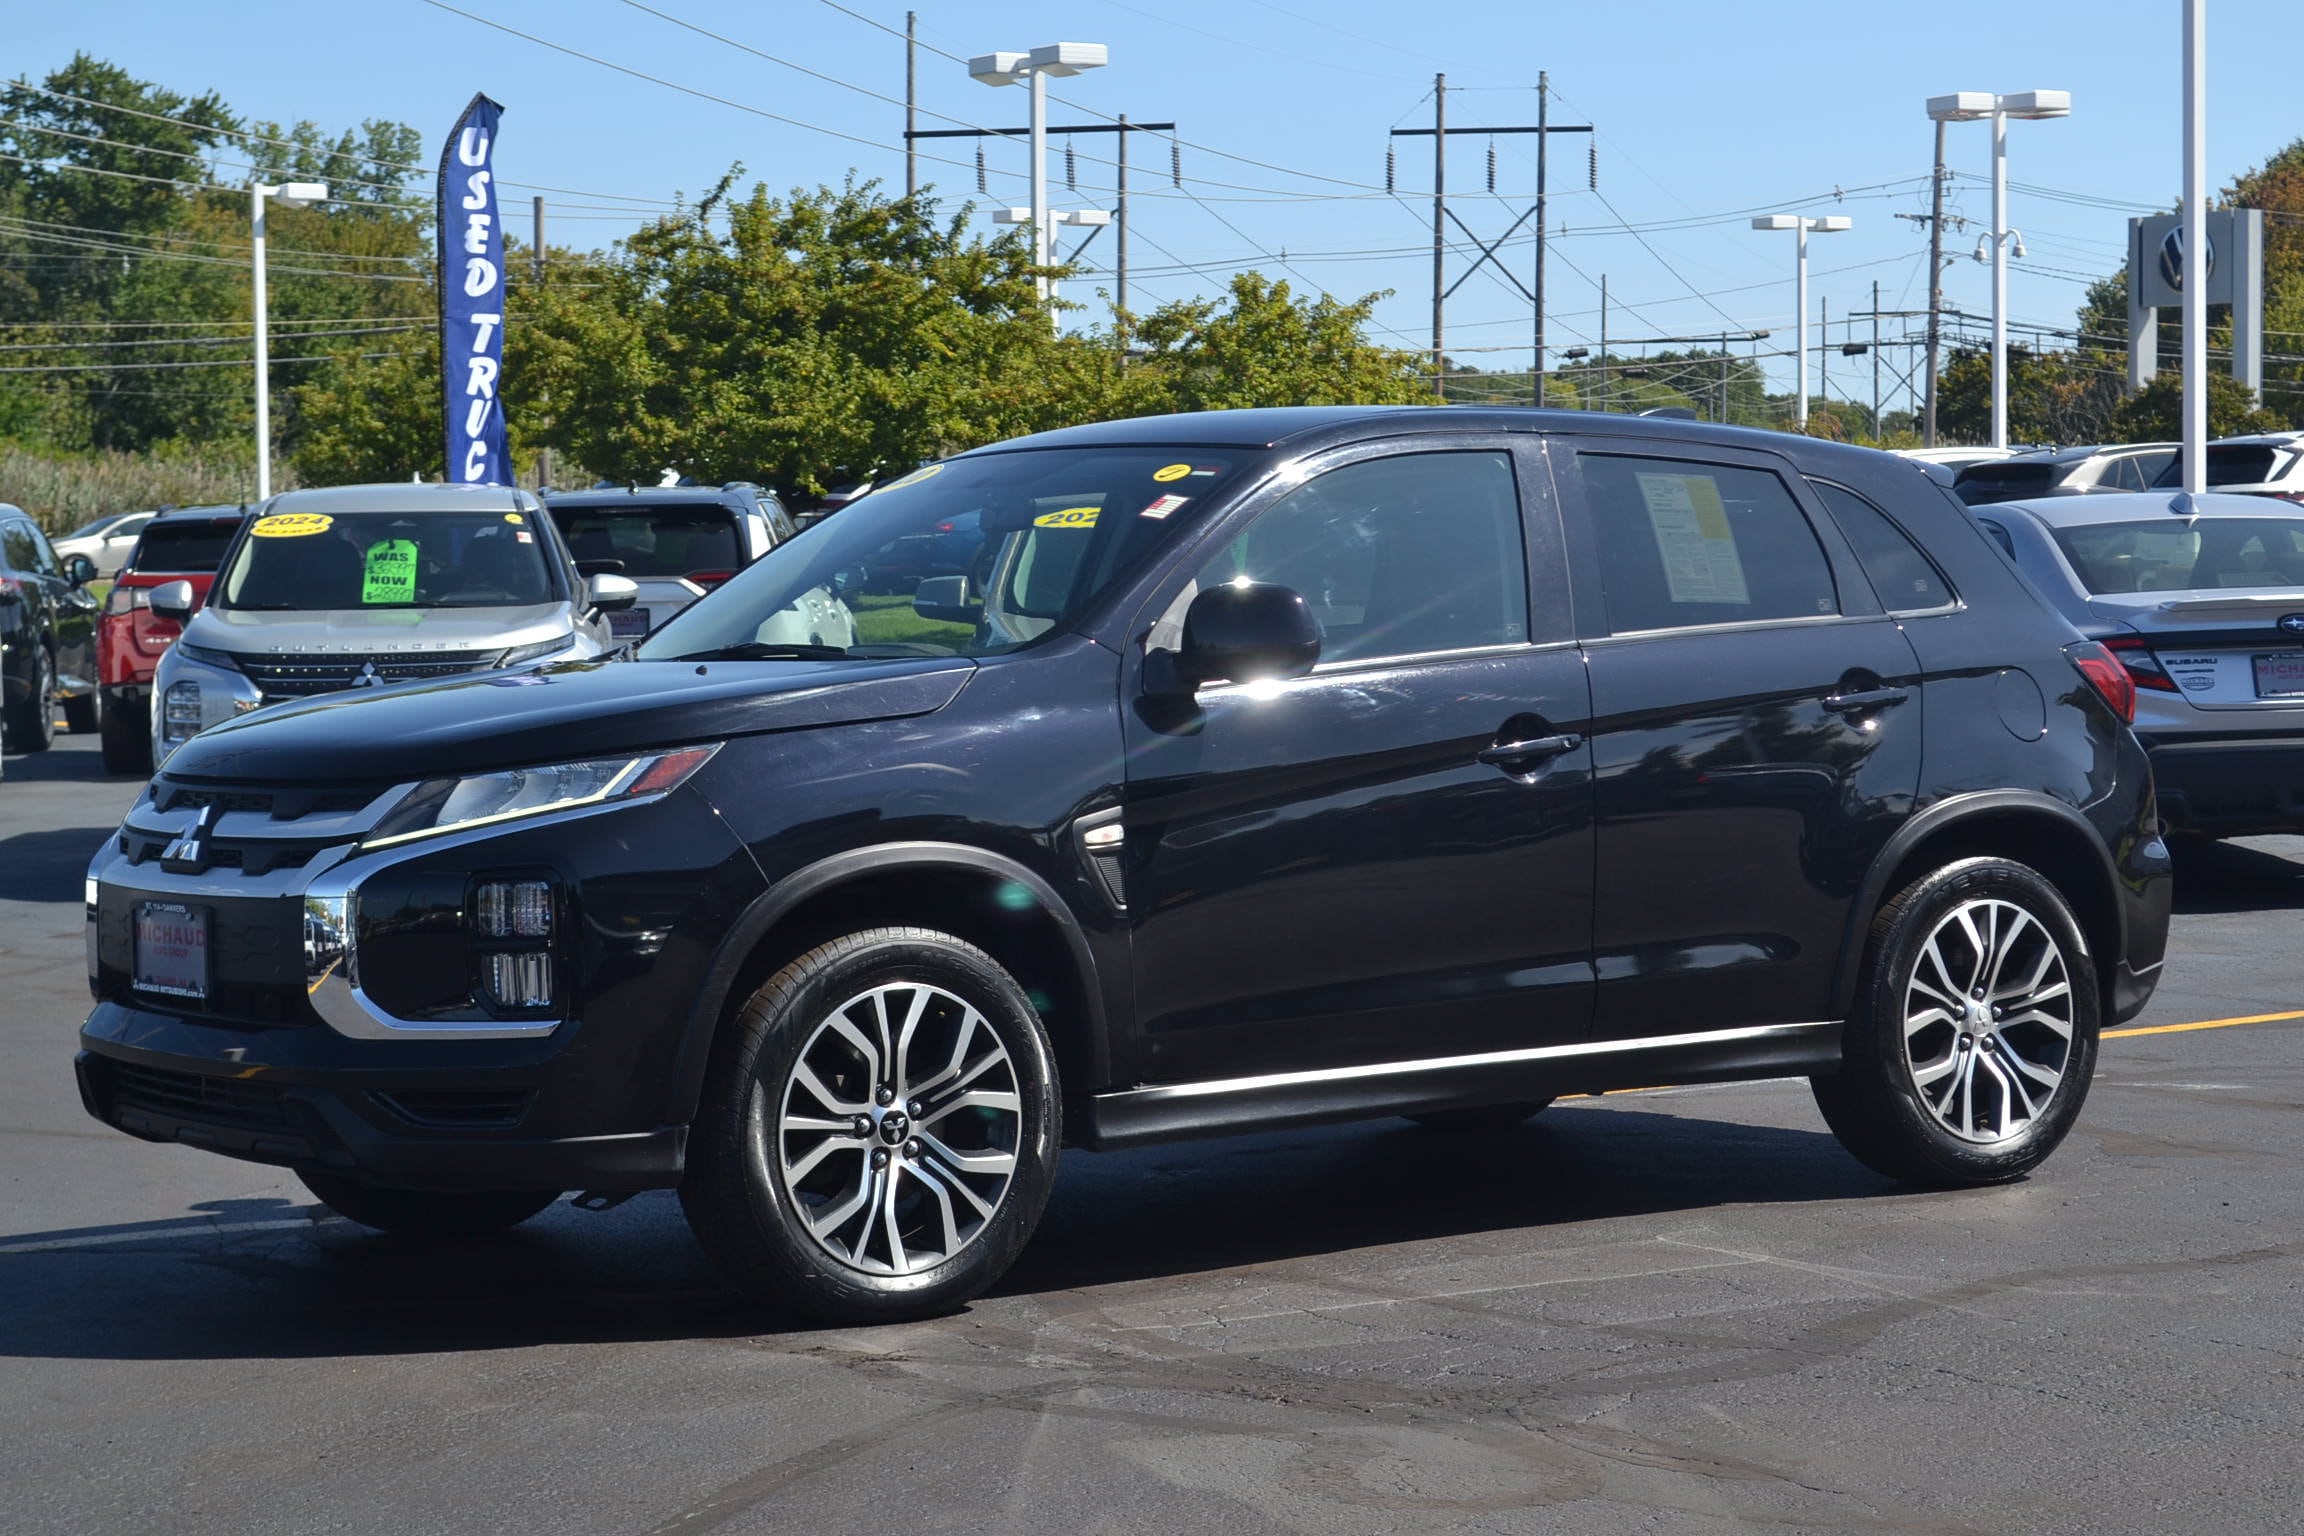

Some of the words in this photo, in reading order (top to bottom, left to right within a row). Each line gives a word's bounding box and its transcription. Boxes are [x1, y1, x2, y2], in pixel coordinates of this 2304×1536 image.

[458, 127, 498, 297] USED
[465, 313, 500, 486] TRUC
[261, 516, 326, 526] 2024
[373, 552, 409, 562] WAS
[370, 576, 408, 586] NOW
[270, 642, 472, 651] OUTLANDER
[2165, 658, 2218, 666] SUBARU
[136, 922, 207, 947] MICHAUD
